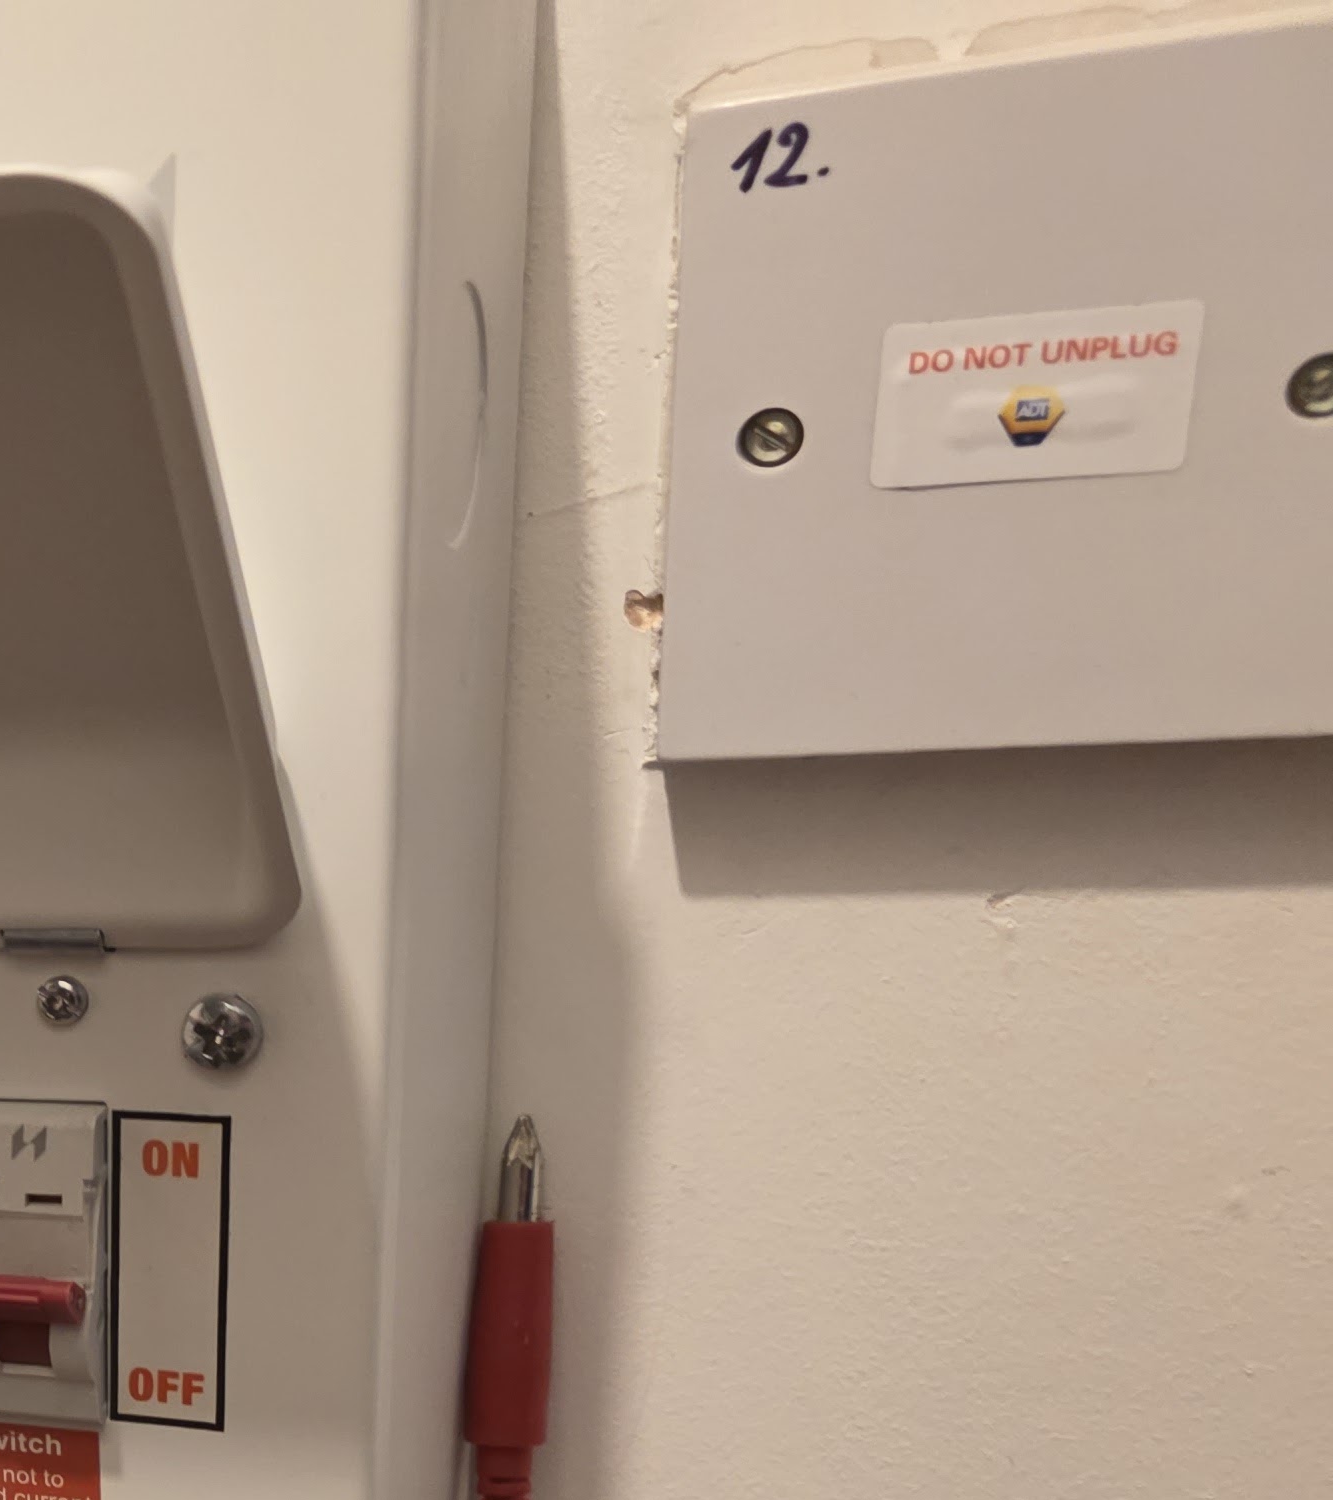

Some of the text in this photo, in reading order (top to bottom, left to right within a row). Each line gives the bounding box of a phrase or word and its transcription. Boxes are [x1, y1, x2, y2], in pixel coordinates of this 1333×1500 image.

[731, 121, 830, 194] 12.
[908, 331, 1178, 375] DO NOT UNPLUG
[1016, 400, 1049, 420] ADT
[142, 1139, 200, 1178] ON
[128, 1367, 205, 1406] OFF
[3, 1469, 37, 1486] not
[44, 1470, 64, 1488] to
